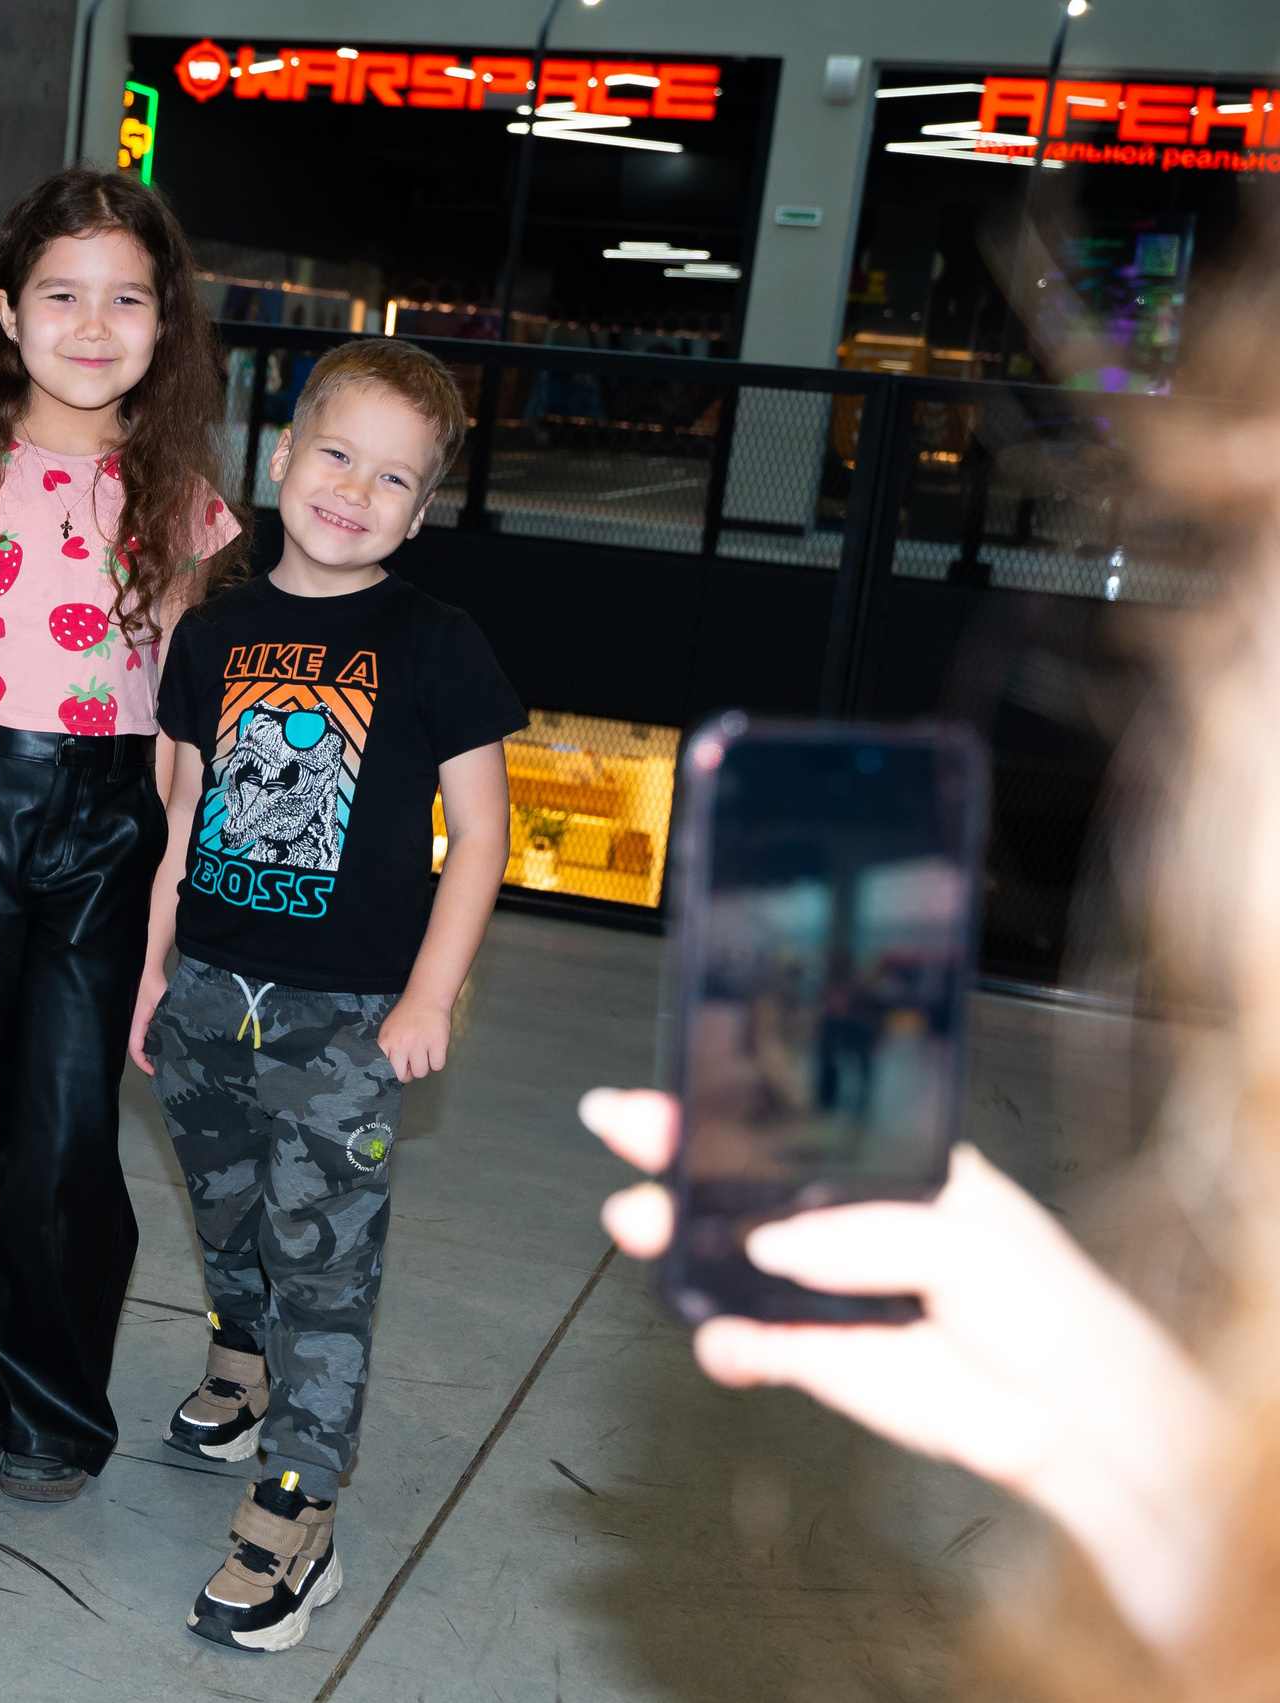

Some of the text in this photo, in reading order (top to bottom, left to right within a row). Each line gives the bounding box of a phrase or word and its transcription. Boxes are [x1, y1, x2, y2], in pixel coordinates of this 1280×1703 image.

[234, 45, 721, 121] WARSPACE
[978, 76, 1280, 147] АРЕН
[223, 643, 379, 688] LIKE A
[191, 847, 335, 918] BOSS
[345, 1150, 375, 1172] ANYTHING
[346, 1125, 366, 1147] WHERE
